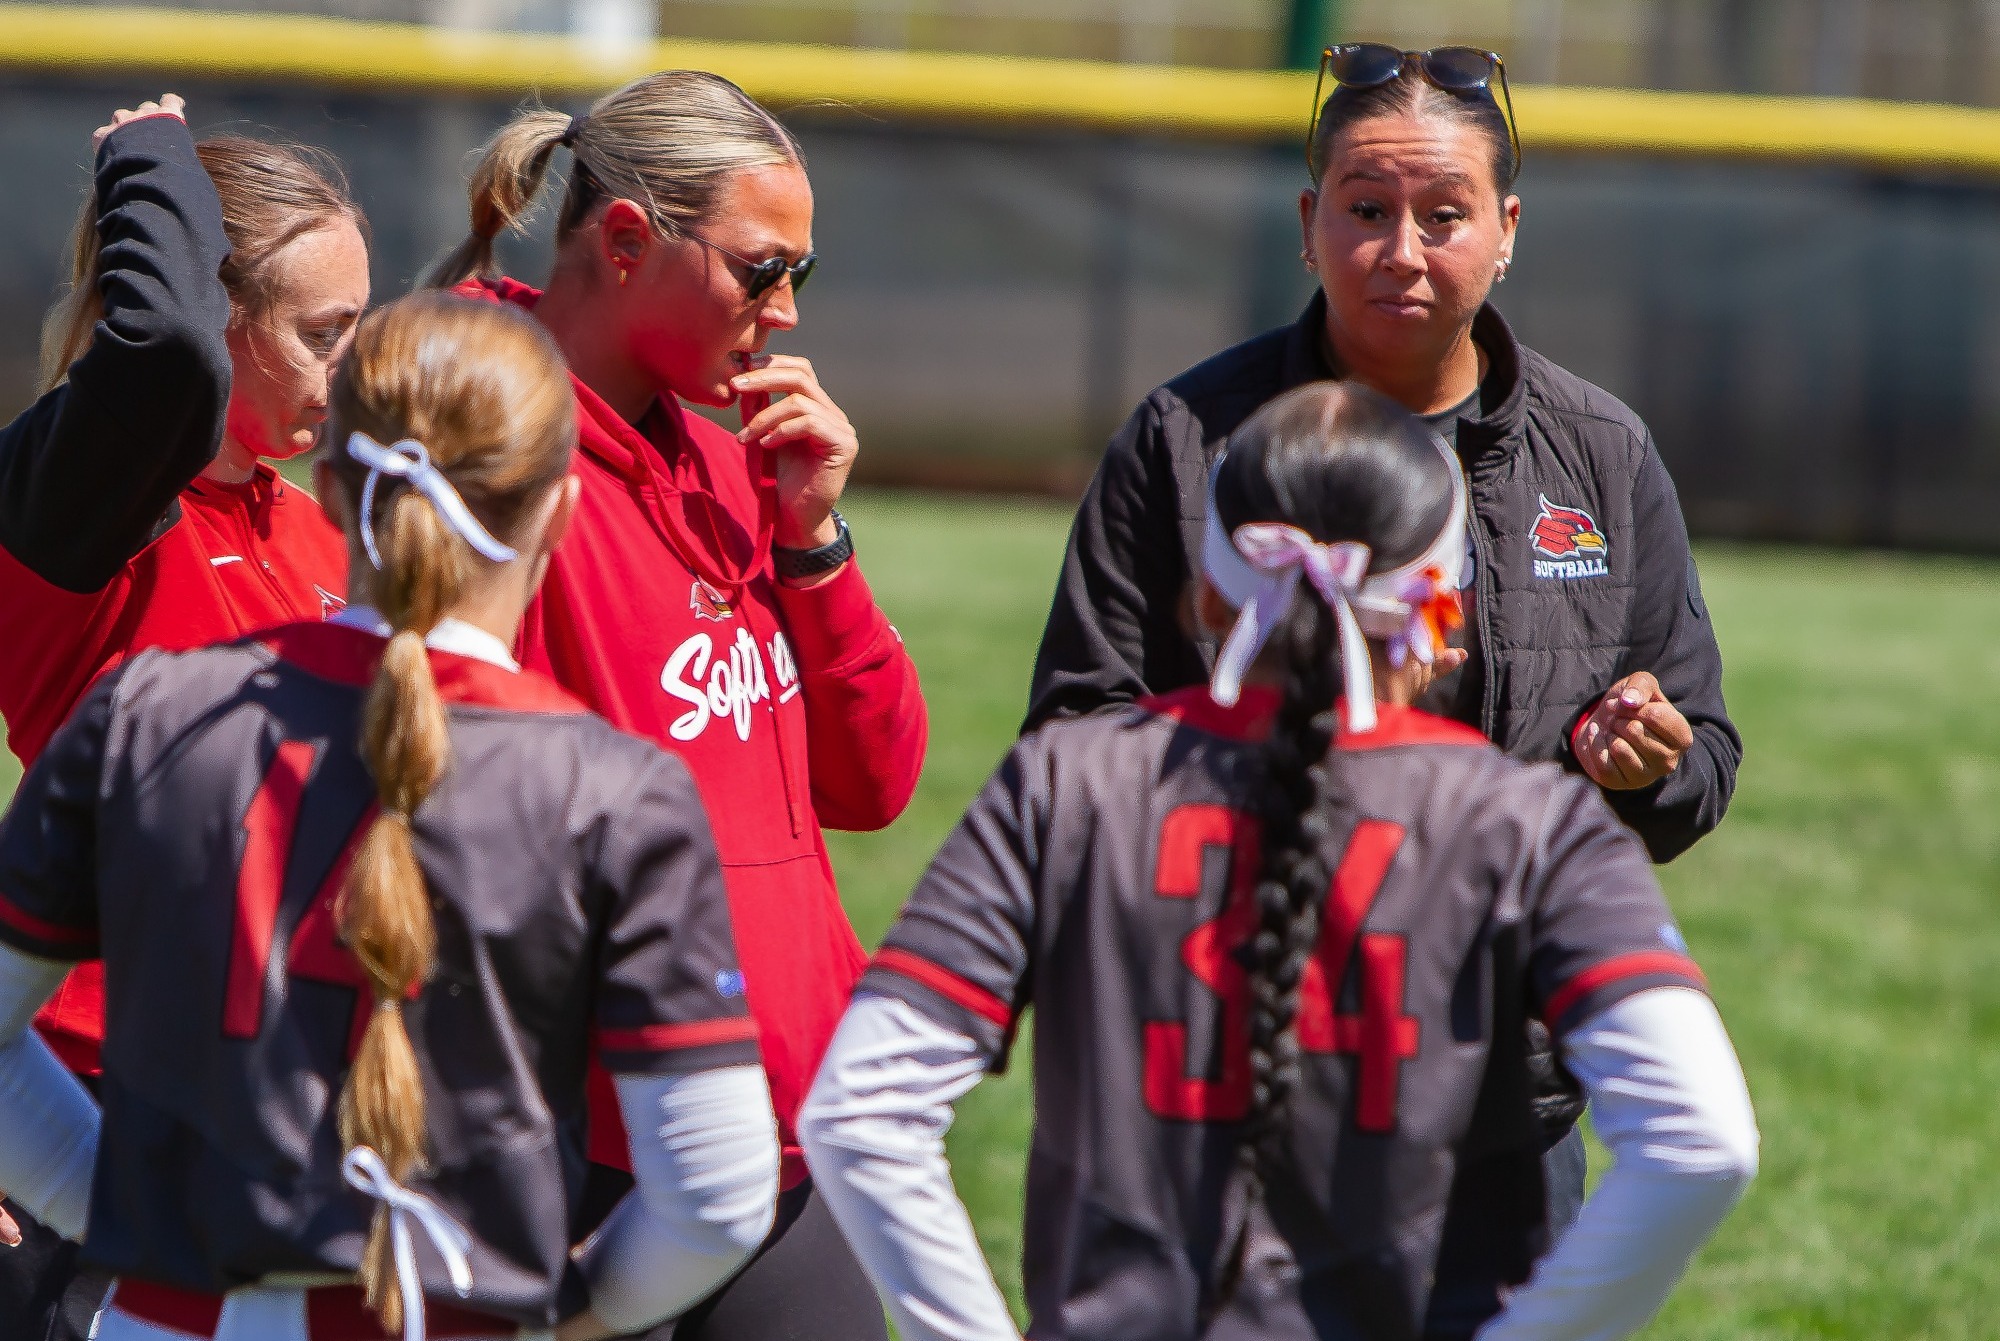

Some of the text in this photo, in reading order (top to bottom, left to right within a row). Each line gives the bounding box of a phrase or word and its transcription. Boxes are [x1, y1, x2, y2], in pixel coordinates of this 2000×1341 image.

[1533, 558, 1609, 579] SOFTBALL
[660, 627, 801, 742] Softa
[1143, 803, 1419, 1132] 34
